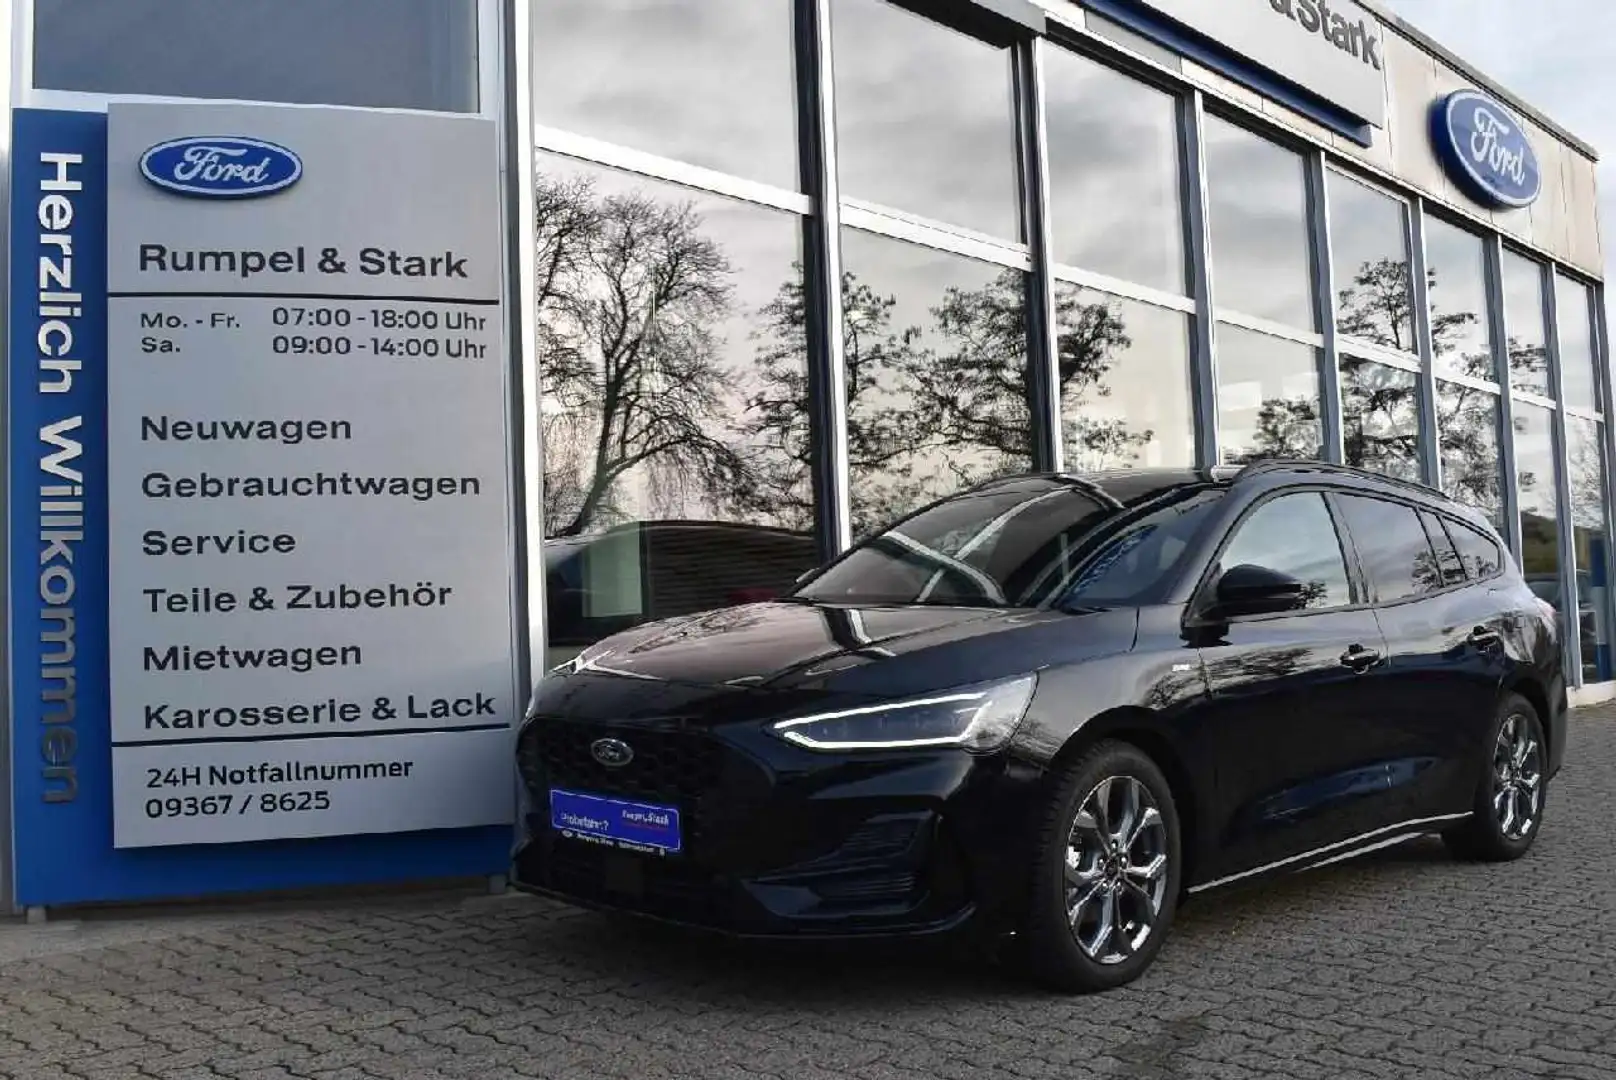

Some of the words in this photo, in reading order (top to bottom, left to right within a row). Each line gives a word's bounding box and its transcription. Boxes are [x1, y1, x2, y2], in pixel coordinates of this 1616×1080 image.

[1297, 0, 1381, 71] Stark
[1470, 107, 1525, 187] Ford
[173, 145, 271, 183] Ford
[38, 152, 83, 393] Herzlich
[139, 244, 304, 278] Rumpel
[317, 247, 347, 274] &
[359, 247, 468, 278] Stark
[140, 312, 188, 328] Mo.
[210, 312, 241, 328] Fr.
[445, 312, 487, 331] Uhr
[141, 337, 181, 354] Sa.
[445, 339, 487, 359] Uhr
[141, 415, 352, 445] Neuwagen
[141, 472, 481, 502] Gebrauchtwagen
[142, 529, 296, 556] Service
[39, 415, 84, 804] Willkommen
[143, 587, 236, 613] Teile
[248, 586, 274, 611] &
[286, 581, 452, 610] Zubehör
[143, 643, 362, 673] Mietwagen
[144, 698, 361, 729] Karosserie
[371, 697, 397, 721] &
[407, 692, 496, 719] Lack
[146, 766, 201, 789] 24H
[208, 760, 414, 786] Notfallnummer
[145, 795, 233, 819] 09367
[239, 794, 253, 815] /
[260, 790, 330, 813] 8625
